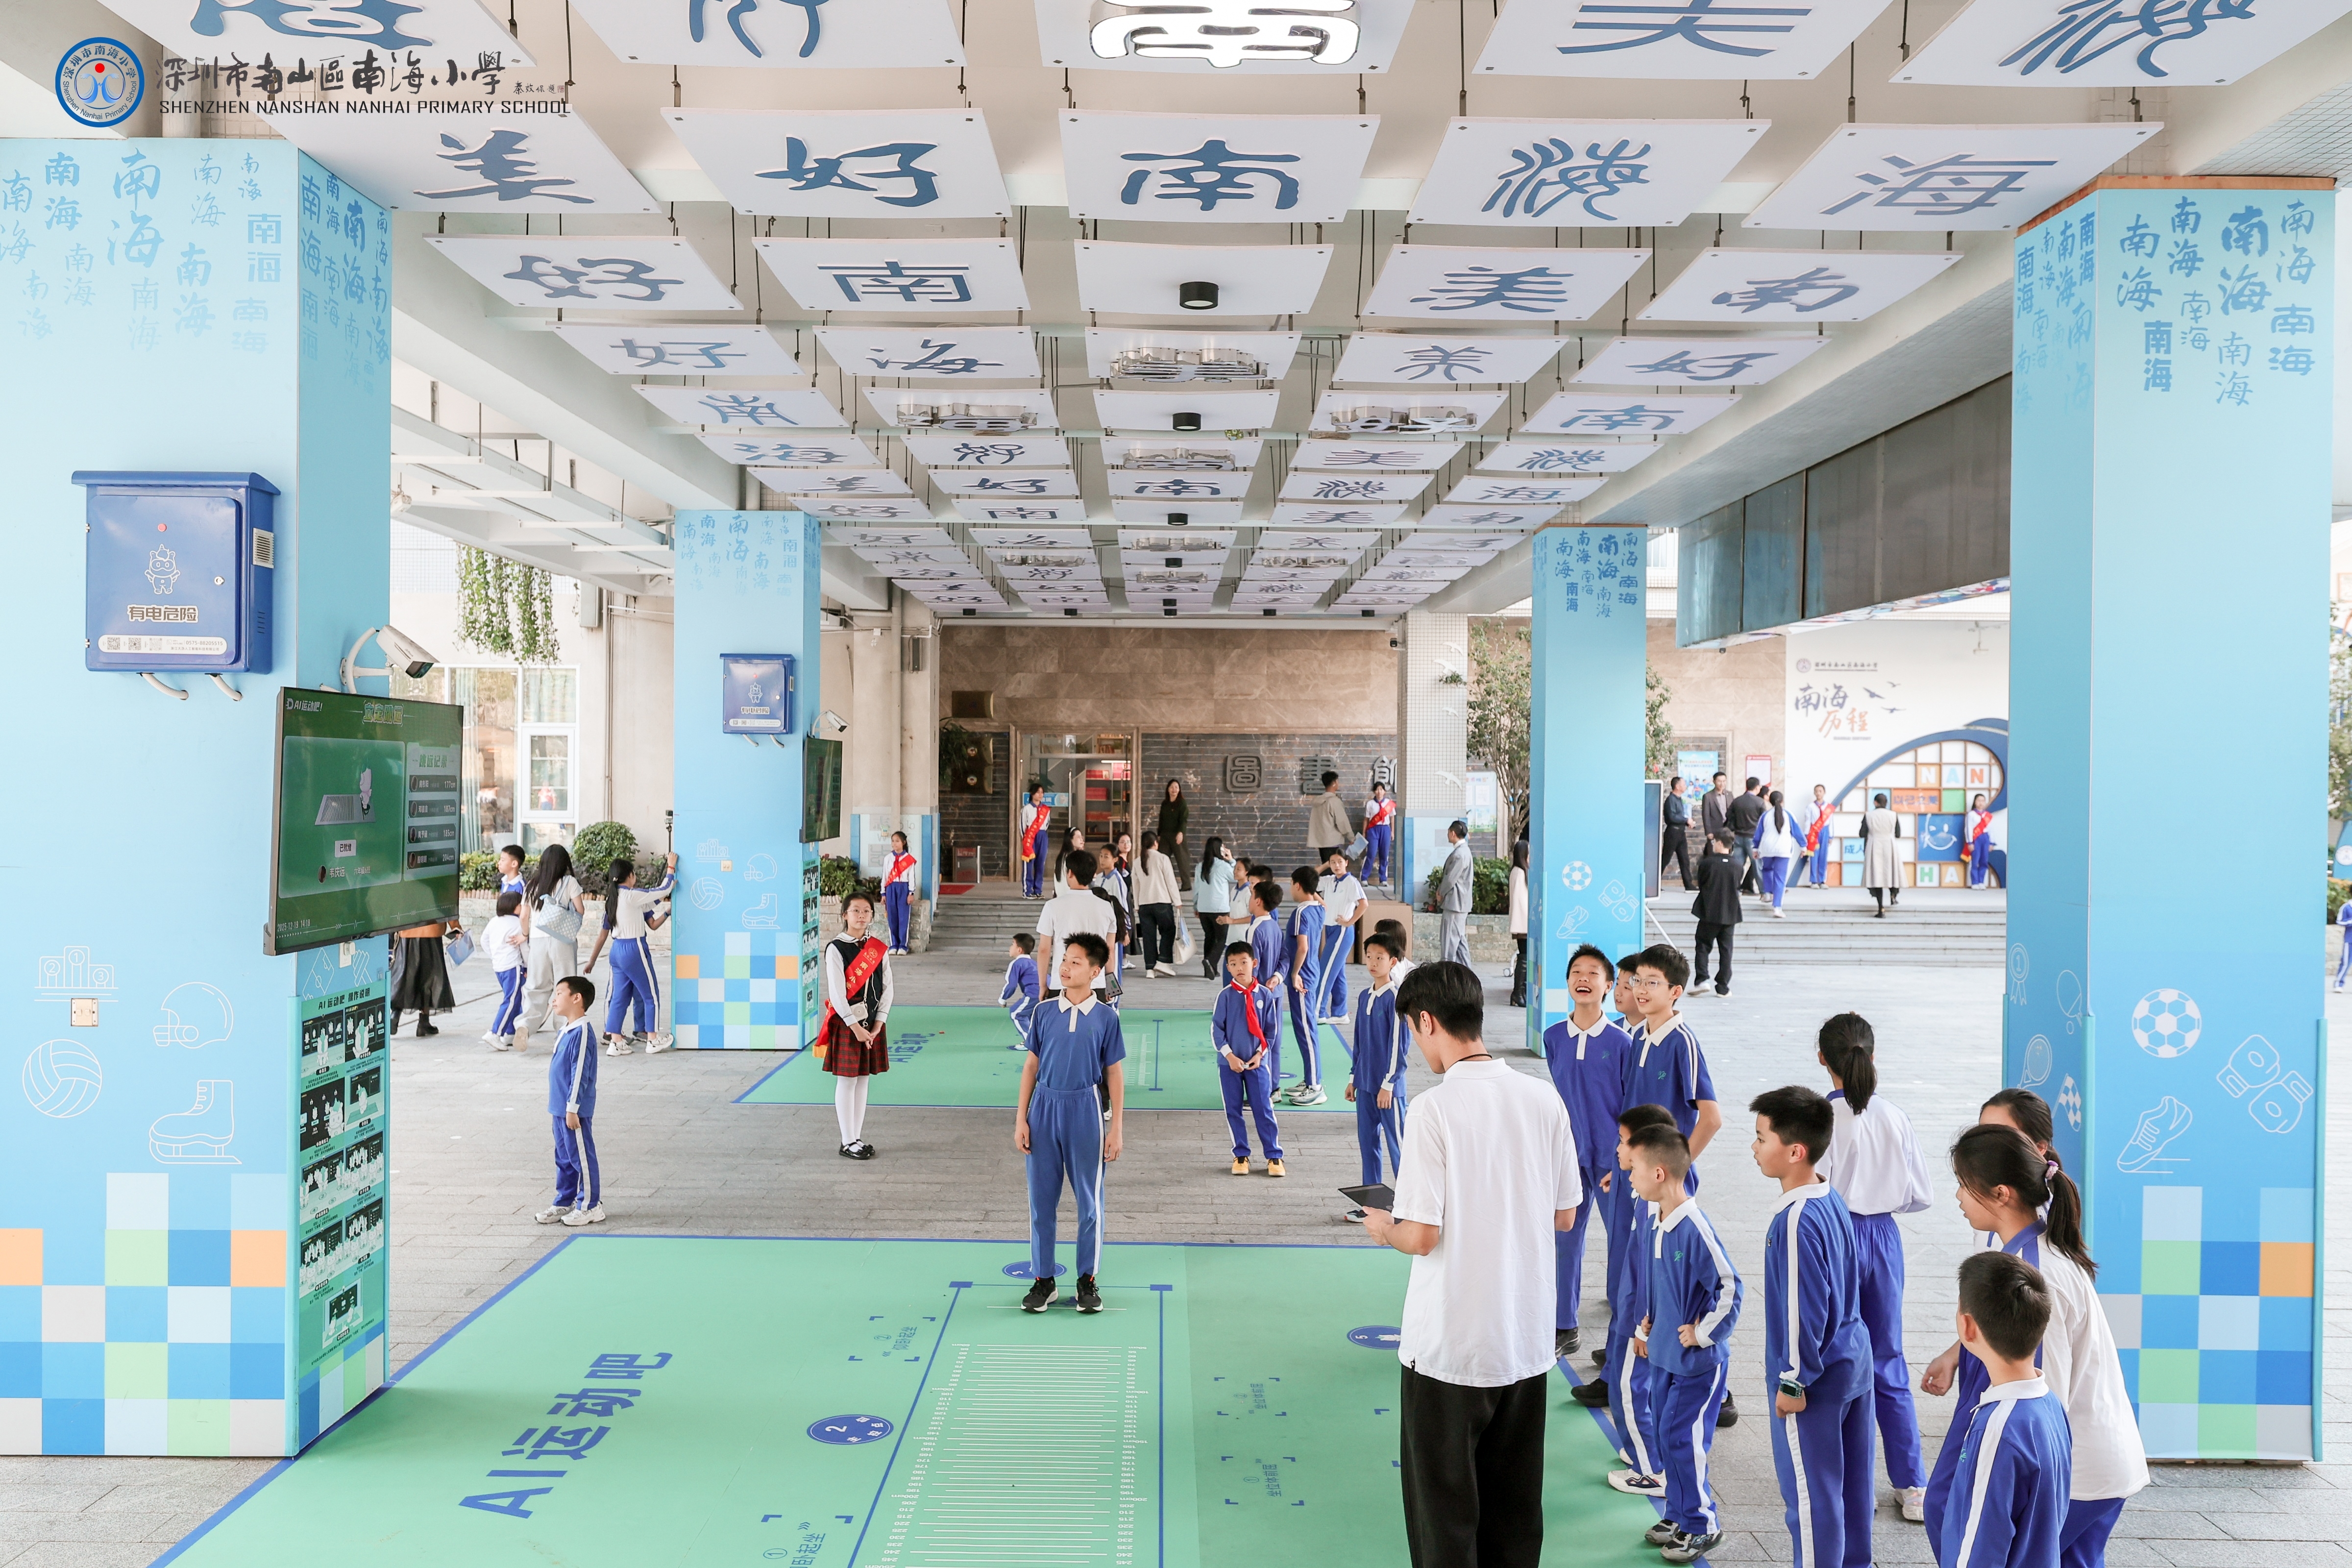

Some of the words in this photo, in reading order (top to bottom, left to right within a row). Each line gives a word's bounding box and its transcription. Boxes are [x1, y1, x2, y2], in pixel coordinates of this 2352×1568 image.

[45, 152, 82, 231] 南海
[191, 153, 225, 227] 南海
[238, 152, 262, 201] 南海
[755, 137, 939, 207] 好
[1121, 140, 1300, 211] 南
[1819, 153, 2058, 216] 海
[0, 170, 36, 264] 南海
[107, 148, 164, 268] 南海
[301, 175, 322, 277] 南海
[325, 173, 340, 235] 南海
[247, 214, 281, 282] 南海
[342, 200, 367, 305] 南海
[374, 210, 388, 267] 南海
[2038, 228, 2056, 290] 南海
[2079, 212, 2096, 287] 南海
[2167, 196, 2204, 277] 南海
[2218, 205, 2272, 316] 南海
[2276, 199, 2316, 285] 南海
[64, 243, 96, 307] 南海
[172, 242, 216, 338] 南海
[817, 262, 972, 302] 南
[1410, 267, 1574, 313] 美
[2017, 247, 2034, 319] 南海
[2055, 220, 2076, 308] 南海
[2117, 214, 2162, 313] 南海
[17, 270, 53, 340] 南海
[128, 277, 162, 353] 南海
[323, 256, 341, 329] 南海
[366, 267, 390, 365] 南海
[231, 297, 270, 354] 南海
[301, 288, 318, 363] 南海
[2032, 307, 2049, 370] 南海
[2180, 291, 2211, 353] 南海
[2268, 304, 2315, 376] 南海
[609, 338, 747, 368] 好
[2143, 320, 2173, 392] 南海
[2215, 331, 2253, 407] 南海
[1318, 450, 1423, 469] 美
[981, 507, 1058, 519] 南
[1135, 479, 1221, 495] 南
[681, 522, 696, 560] 南海
[701, 514, 716, 547] 南海
[726, 514, 750, 563] 南海
[760, 515, 774, 545] 南海
[783, 539, 797, 567] 南海
[1576, 530, 1592, 564] 南海
[1621, 532, 1638, 567] 南海
[753, 551, 770, 589] 南海
[1555, 538, 1574, 579] 南海
[1582, 569, 1594, 595] 南海
[1597, 534, 1620, 580] 南海
[128, 606, 197, 622] 有电危险
[1566, 582, 1579, 612] 南海
[1596, 586, 1612, 618] 南海
[1618, 575, 1638, 605] 南海
[363, 702, 403, 724] 立定跳远
[1795, 682, 1849, 717] 南海
[1818, 708, 1868, 738] 历程
[443, 805, 456, 813] 187cm
[444, 781, 456, 789] 177cm
[442, 829, 455, 837] 185cm
[442, 854, 454, 862] 204cm
[277, 920, 299, 931] 2025-12-19
[300, 919, 311, 928] 14:18
[318, 1001, 326, 1010] AI
[327, 995, 345, 1008] 运动吧
[348, 988, 370, 1002] 操作说明
[1250, 1383, 1267, 1409] 坐位体前屈
[458, 1352, 673, 1519] AI运动吧
[825, 1425, 848, 1433] 2
[1262, 1464, 1282, 1497] 坐位体前屈
